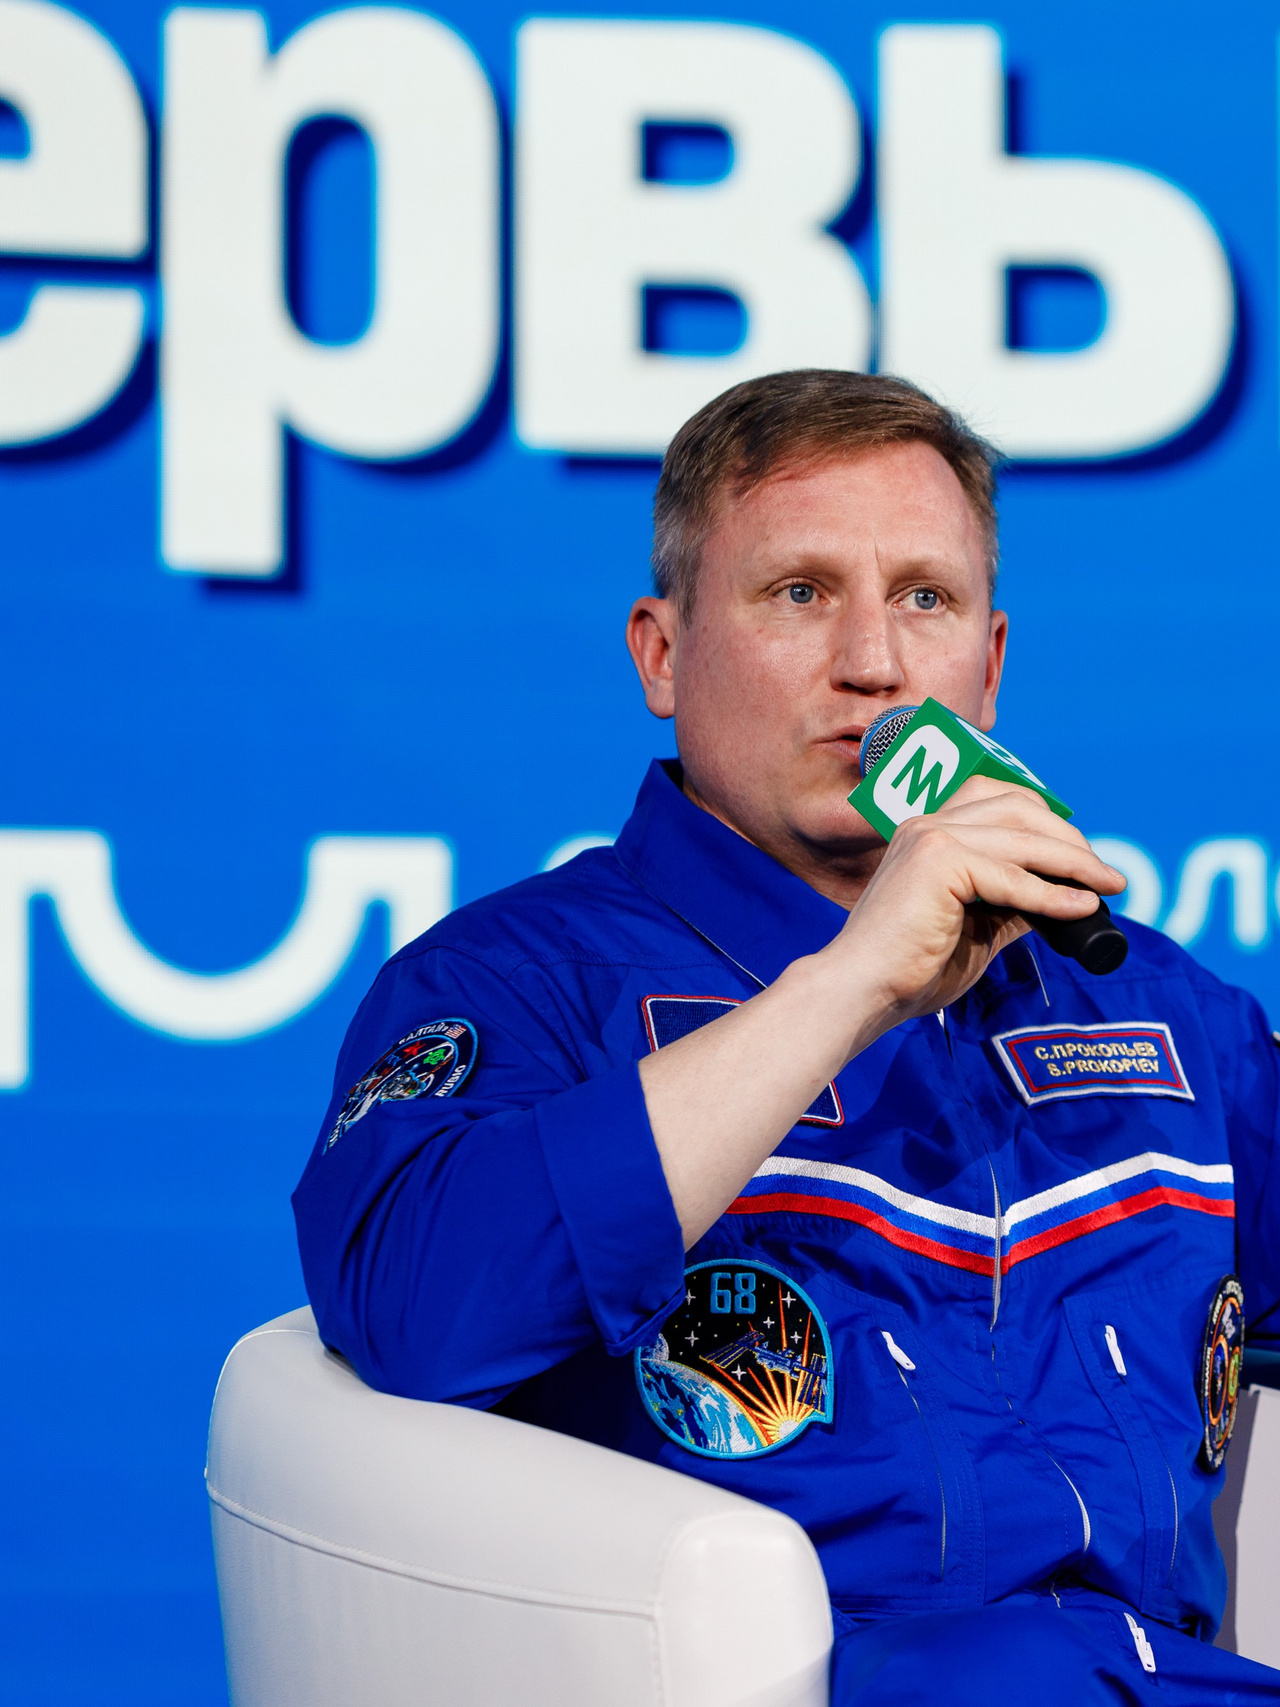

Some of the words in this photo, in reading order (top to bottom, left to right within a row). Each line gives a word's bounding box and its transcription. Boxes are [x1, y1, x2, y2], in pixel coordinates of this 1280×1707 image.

[1033, 1041, 1159, 1061] С.ПРОКОПЬЕВ
[434, 1064, 467, 1097] RUBIO
[1046, 1058, 1160, 1078] S.PROKOPIEV
[709, 1272, 757, 1315] 68
